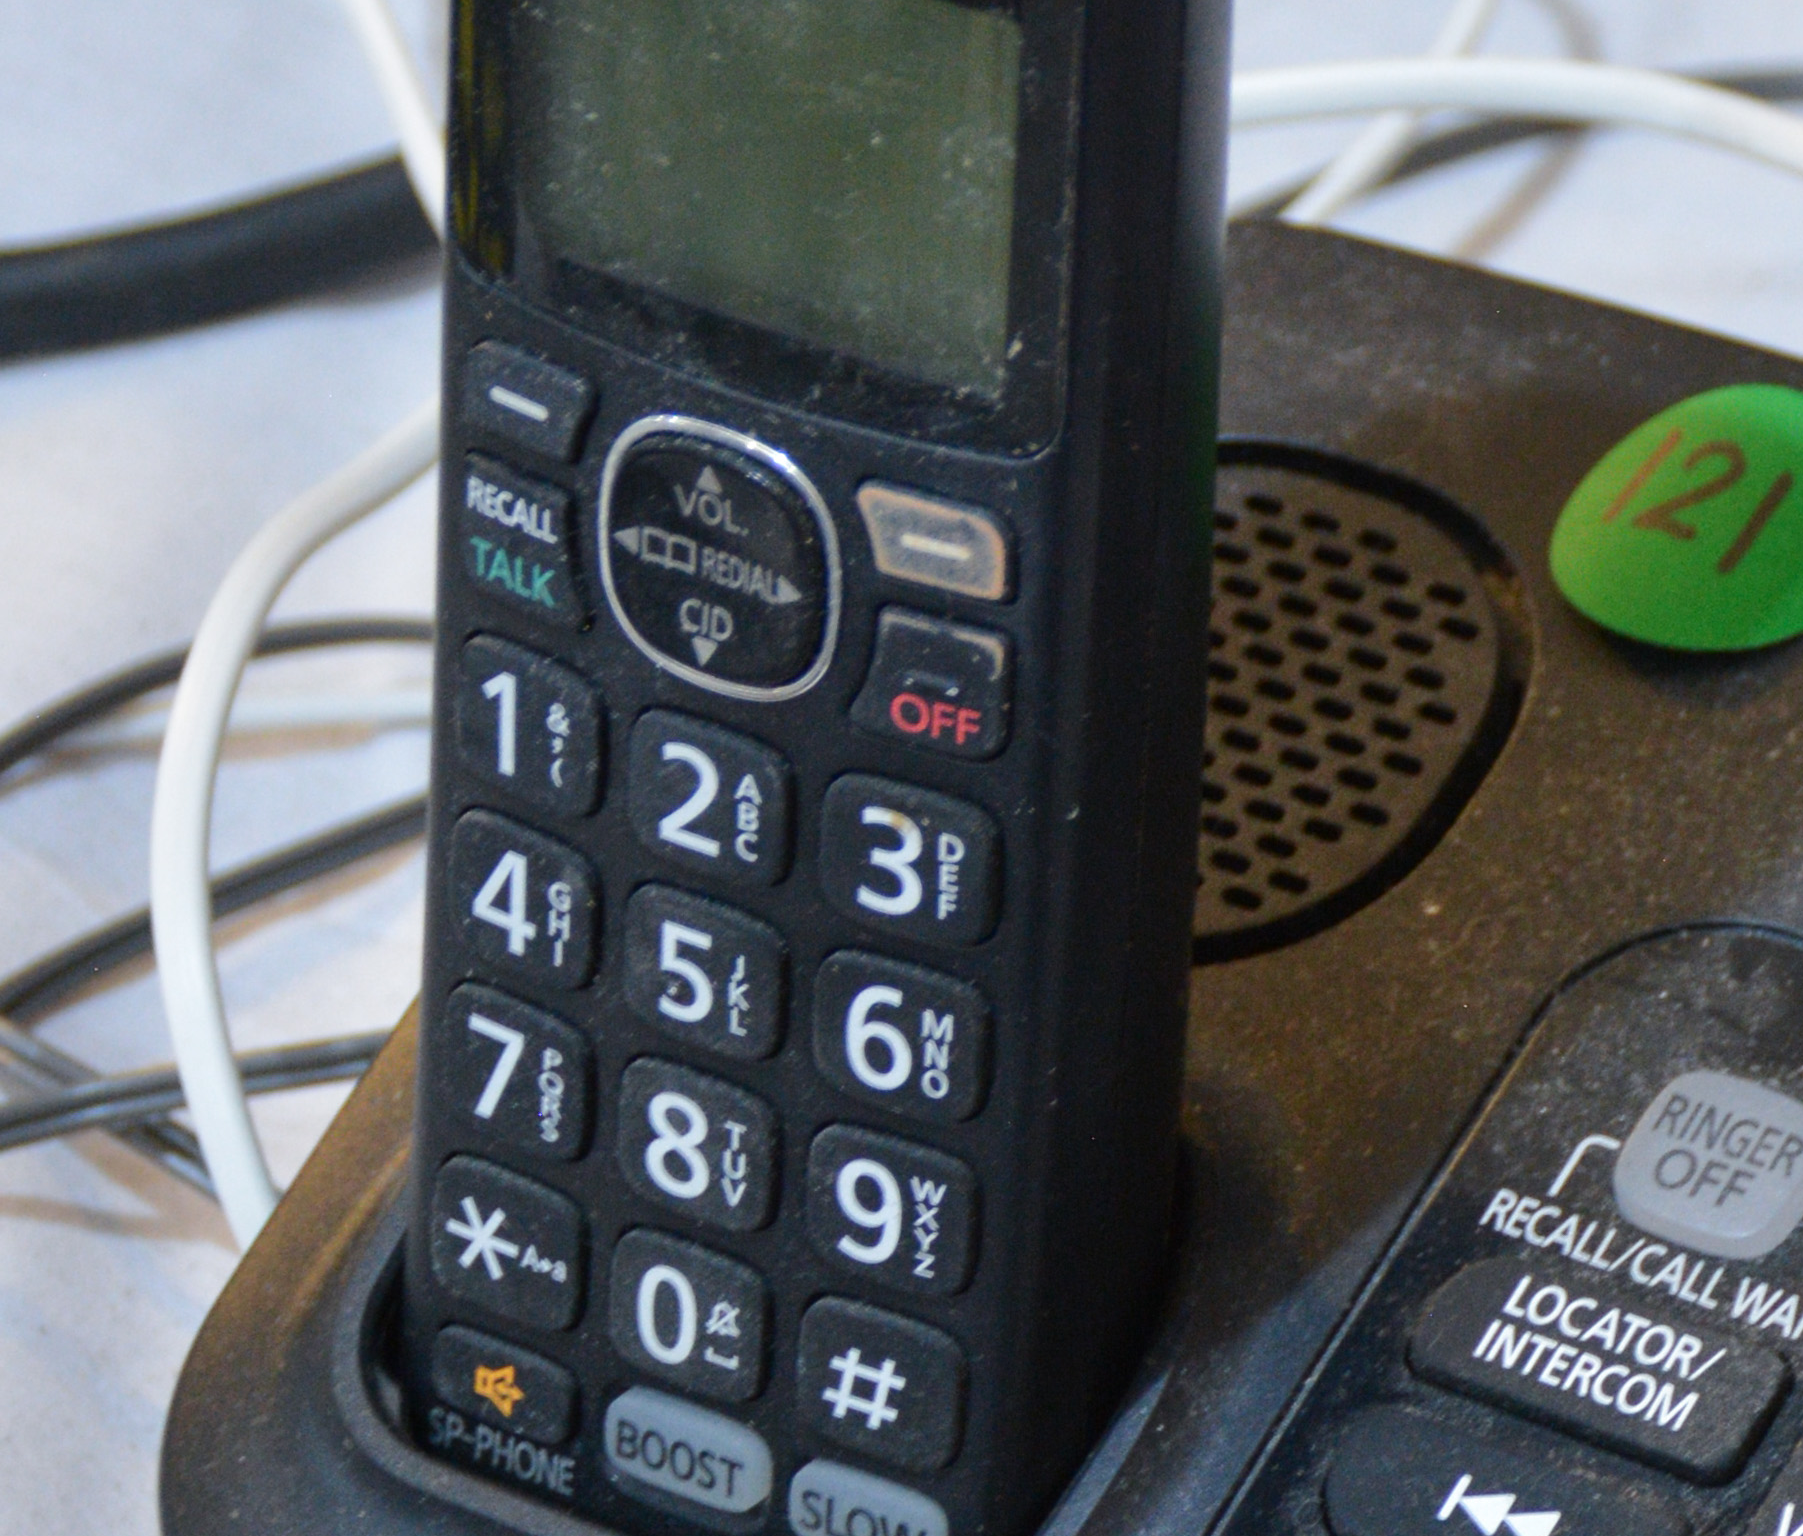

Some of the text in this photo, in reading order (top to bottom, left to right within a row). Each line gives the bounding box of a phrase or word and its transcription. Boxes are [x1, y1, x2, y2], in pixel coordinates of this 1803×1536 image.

[466, 476, 560, 544] RECALL
[672, 483, 750, 537] VOL.
[1602, 427, 1795, 575] 121
[470, 536, 558, 608] TALK
[679, 598, 734, 643] CID
[702, 546, 780, 604] REDIAL
[480, 671, 518, 777] 1
[889, 693, 981, 746] OFF
[658, 741, 721, 860] 2
[471, 849, 536, 957] 4
[855, 806, 923, 916] 3
[657, 920, 714, 1023] 5
[467, 1012, 525, 1120] 7
[844, 985, 913, 1092] 6
[644, 1091, 710, 1200] 8
[1653, 1148, 1756, 1209] OFF
[836, 1158, 902, 1264] 9
[1479, 1188, 1725, 1311] RECALL/CALL
[635, 1263, 698, 1366] 0
[1503, 1275, 1727, 1381] LOCATOR/
[1472, 1319, 1699, 1433] INTERCOM
[428, 1407, 576, 1497] SP-PHONE
[615, 1418, 745, 1499] BOOST
